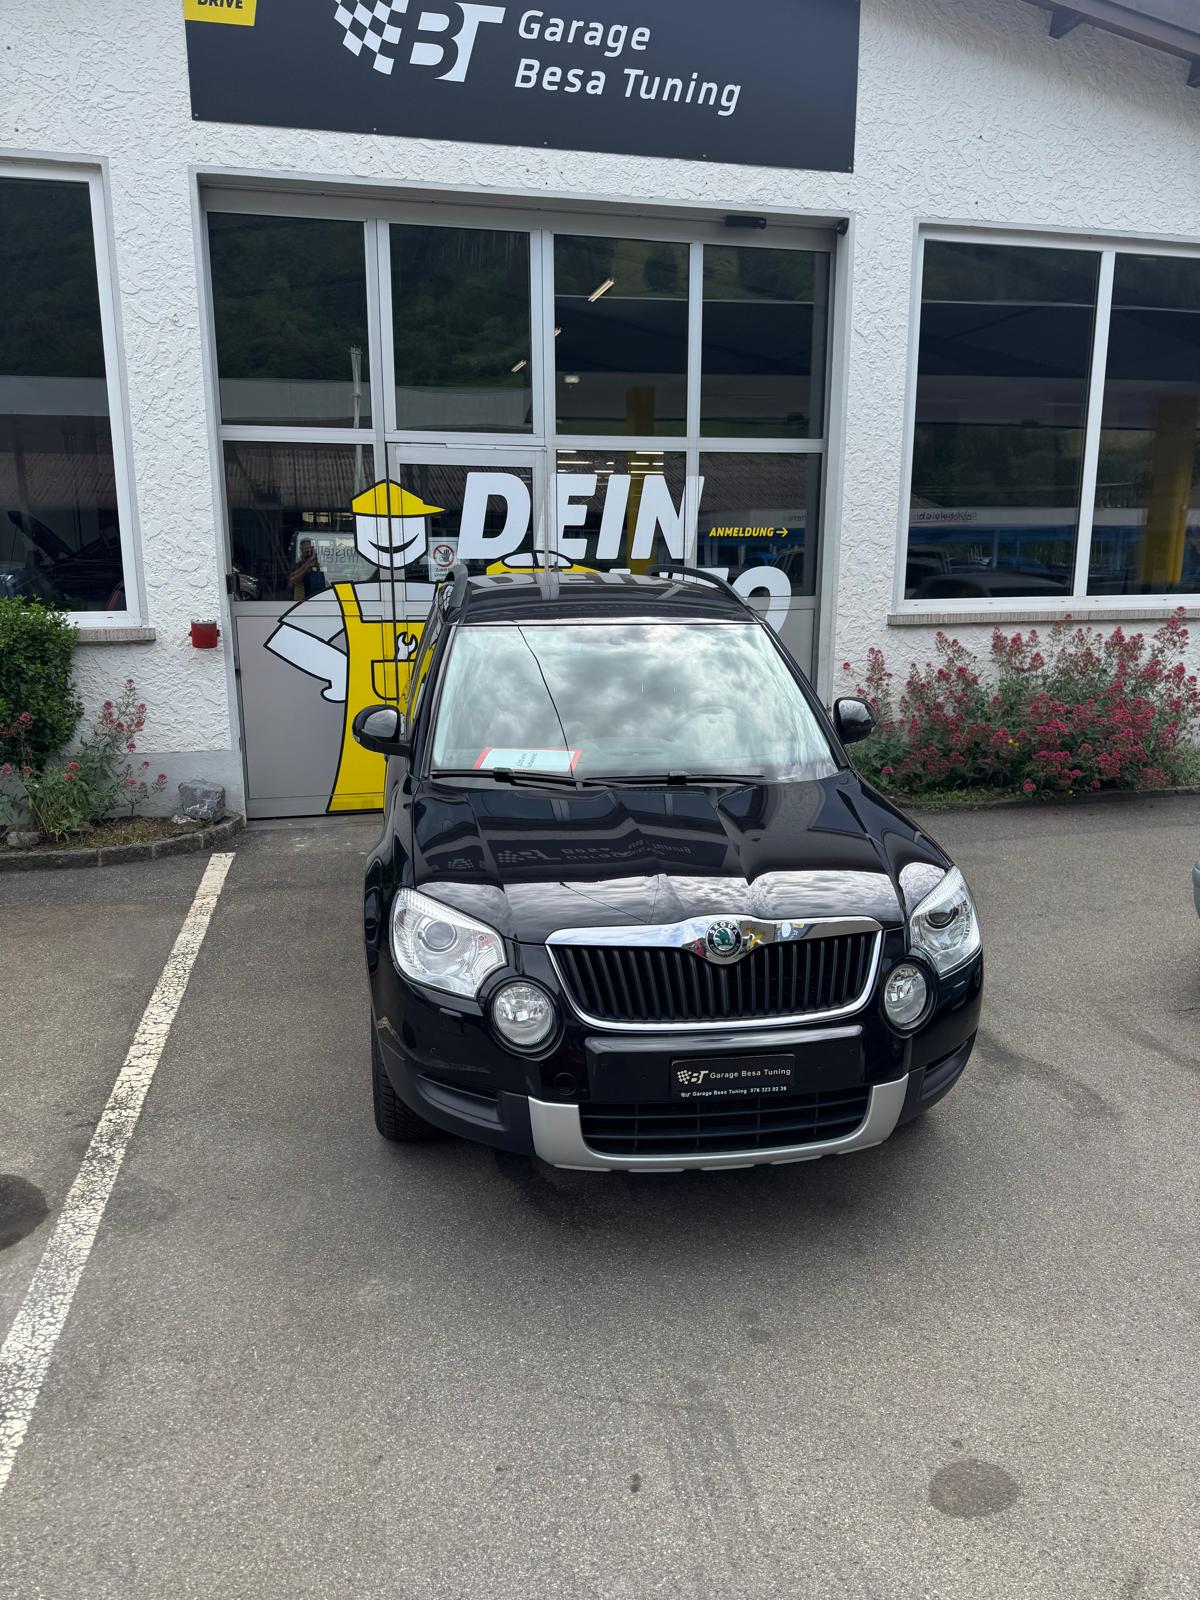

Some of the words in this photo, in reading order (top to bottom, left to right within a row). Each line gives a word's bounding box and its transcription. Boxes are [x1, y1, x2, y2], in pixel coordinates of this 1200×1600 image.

[518, 9, 651, 57] Garage
[513, 58, 604, 96] Besa
[623, 68, 742, 117] Tuning
[457, 472, 705, 560] DEIN
[709, 527, 775, 537] ANMELDUNG
[764, 1068, 791, 1076] Tuning
